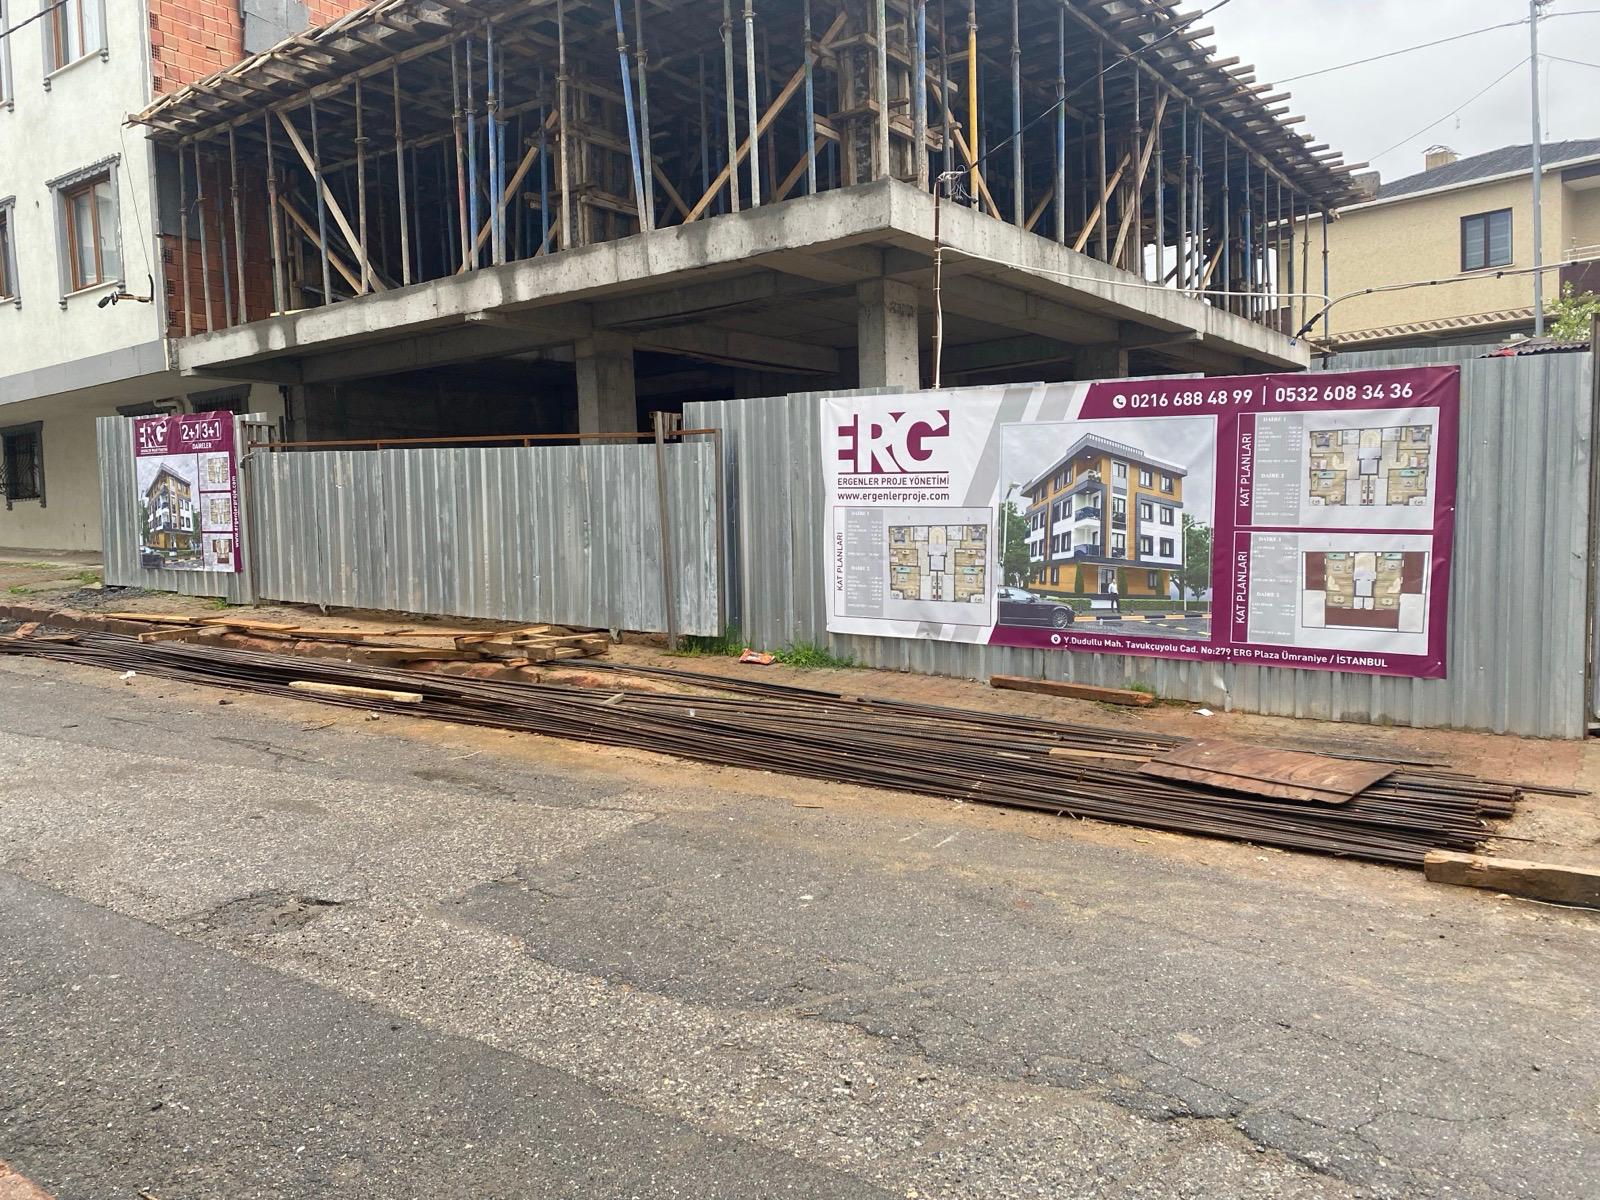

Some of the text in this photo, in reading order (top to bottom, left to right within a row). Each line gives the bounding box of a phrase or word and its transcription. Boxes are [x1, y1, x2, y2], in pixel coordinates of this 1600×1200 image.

[1131, 382, 1413, 408] 0216 688 48 99 0532 608 34 36
[181, 421, 220, 440] 2+1 3+1
[838, 410, 949, 473] ERG
[837, 475, 949, 486] ERGENLER PROJE YÖNETİMİ
[1240, 433, 1252, 507] KAT PLANLARI
[837, 491, 949, 503] www.ergenlerproje.com
[1235, 551, 1248, 624] KAT PLANLARI
[1064, 636, 1102, 646] Y.Dudullu
[1104, 639, 1124, 648] Mah.
[1126, 640, 1178, 652] Tavukçuyolu
[1180, 644, 1199, 654] Cad.
[1200, 646, 1230, 656] No:279
[1233, 648, 1252, 657] ERG
[1254, 650, 1279, 660] Plaza
[1282, 650, 1327, 663] Ümraniye
[1336, 655, 1388, 668] İSTANBUL
